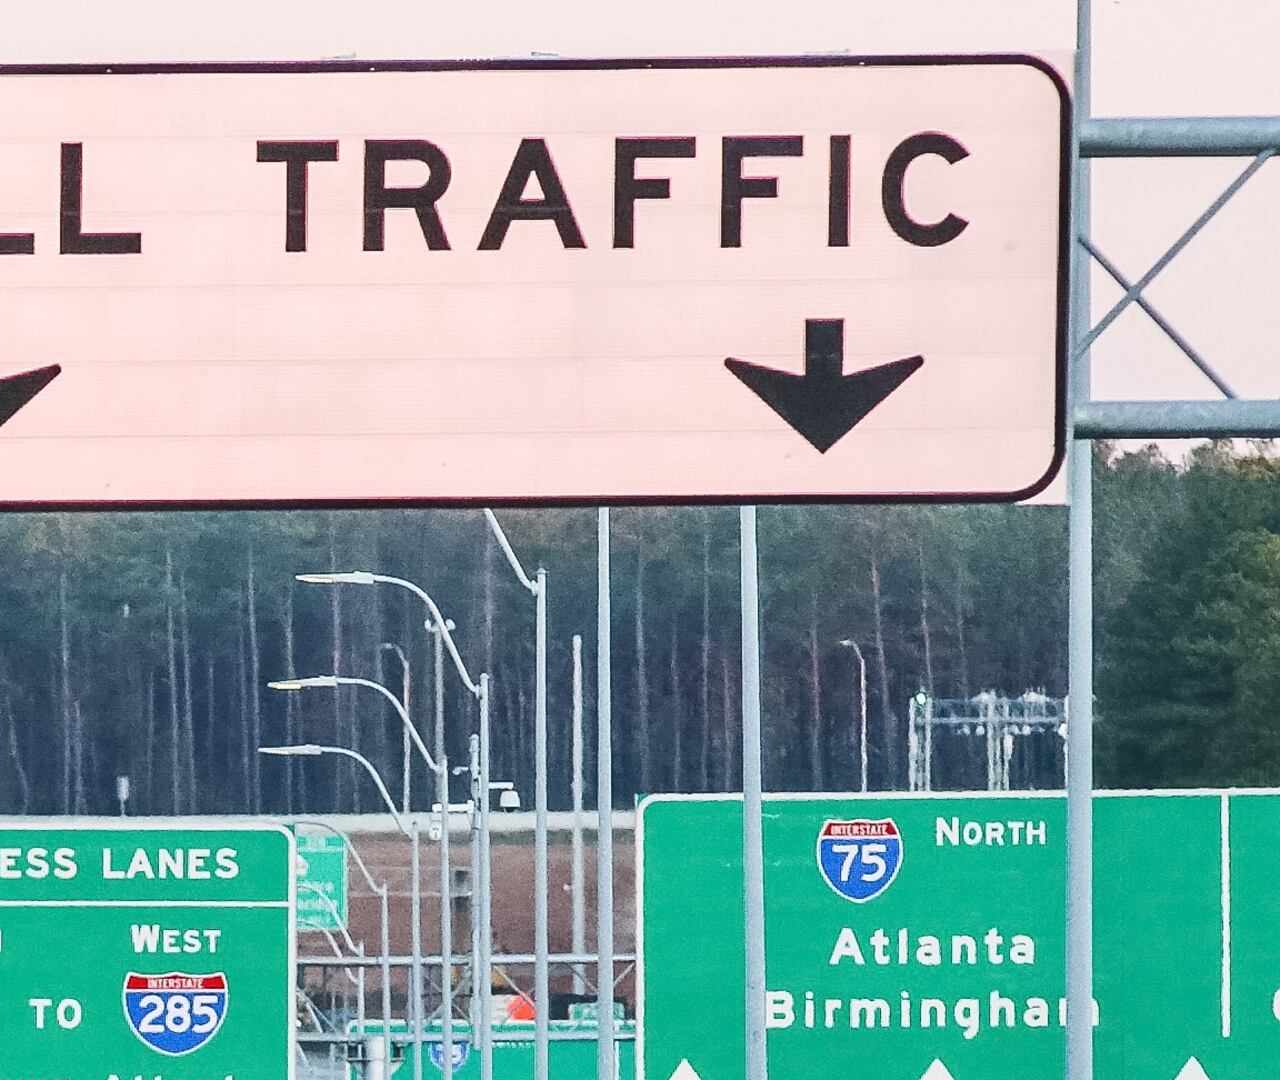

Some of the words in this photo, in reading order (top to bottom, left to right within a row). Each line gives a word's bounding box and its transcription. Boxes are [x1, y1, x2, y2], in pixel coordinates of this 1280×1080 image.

[256, 132, 972, 254] TRAFFIC
[830, 823, 889, 836] INTERSTATE
[935, 816, 1047, 847] NORTH
[102, 847, 240, 880] LANES
[831, 843, 887, 883] 75
[130, 924, 222, 954] WEST
[828, 927, 1036, 967] Atlanta
[146, 978, 204, 989] INTERSTATE
[28, 998, 83, 1030] TO
[138, 995, 219, 1034] 285
